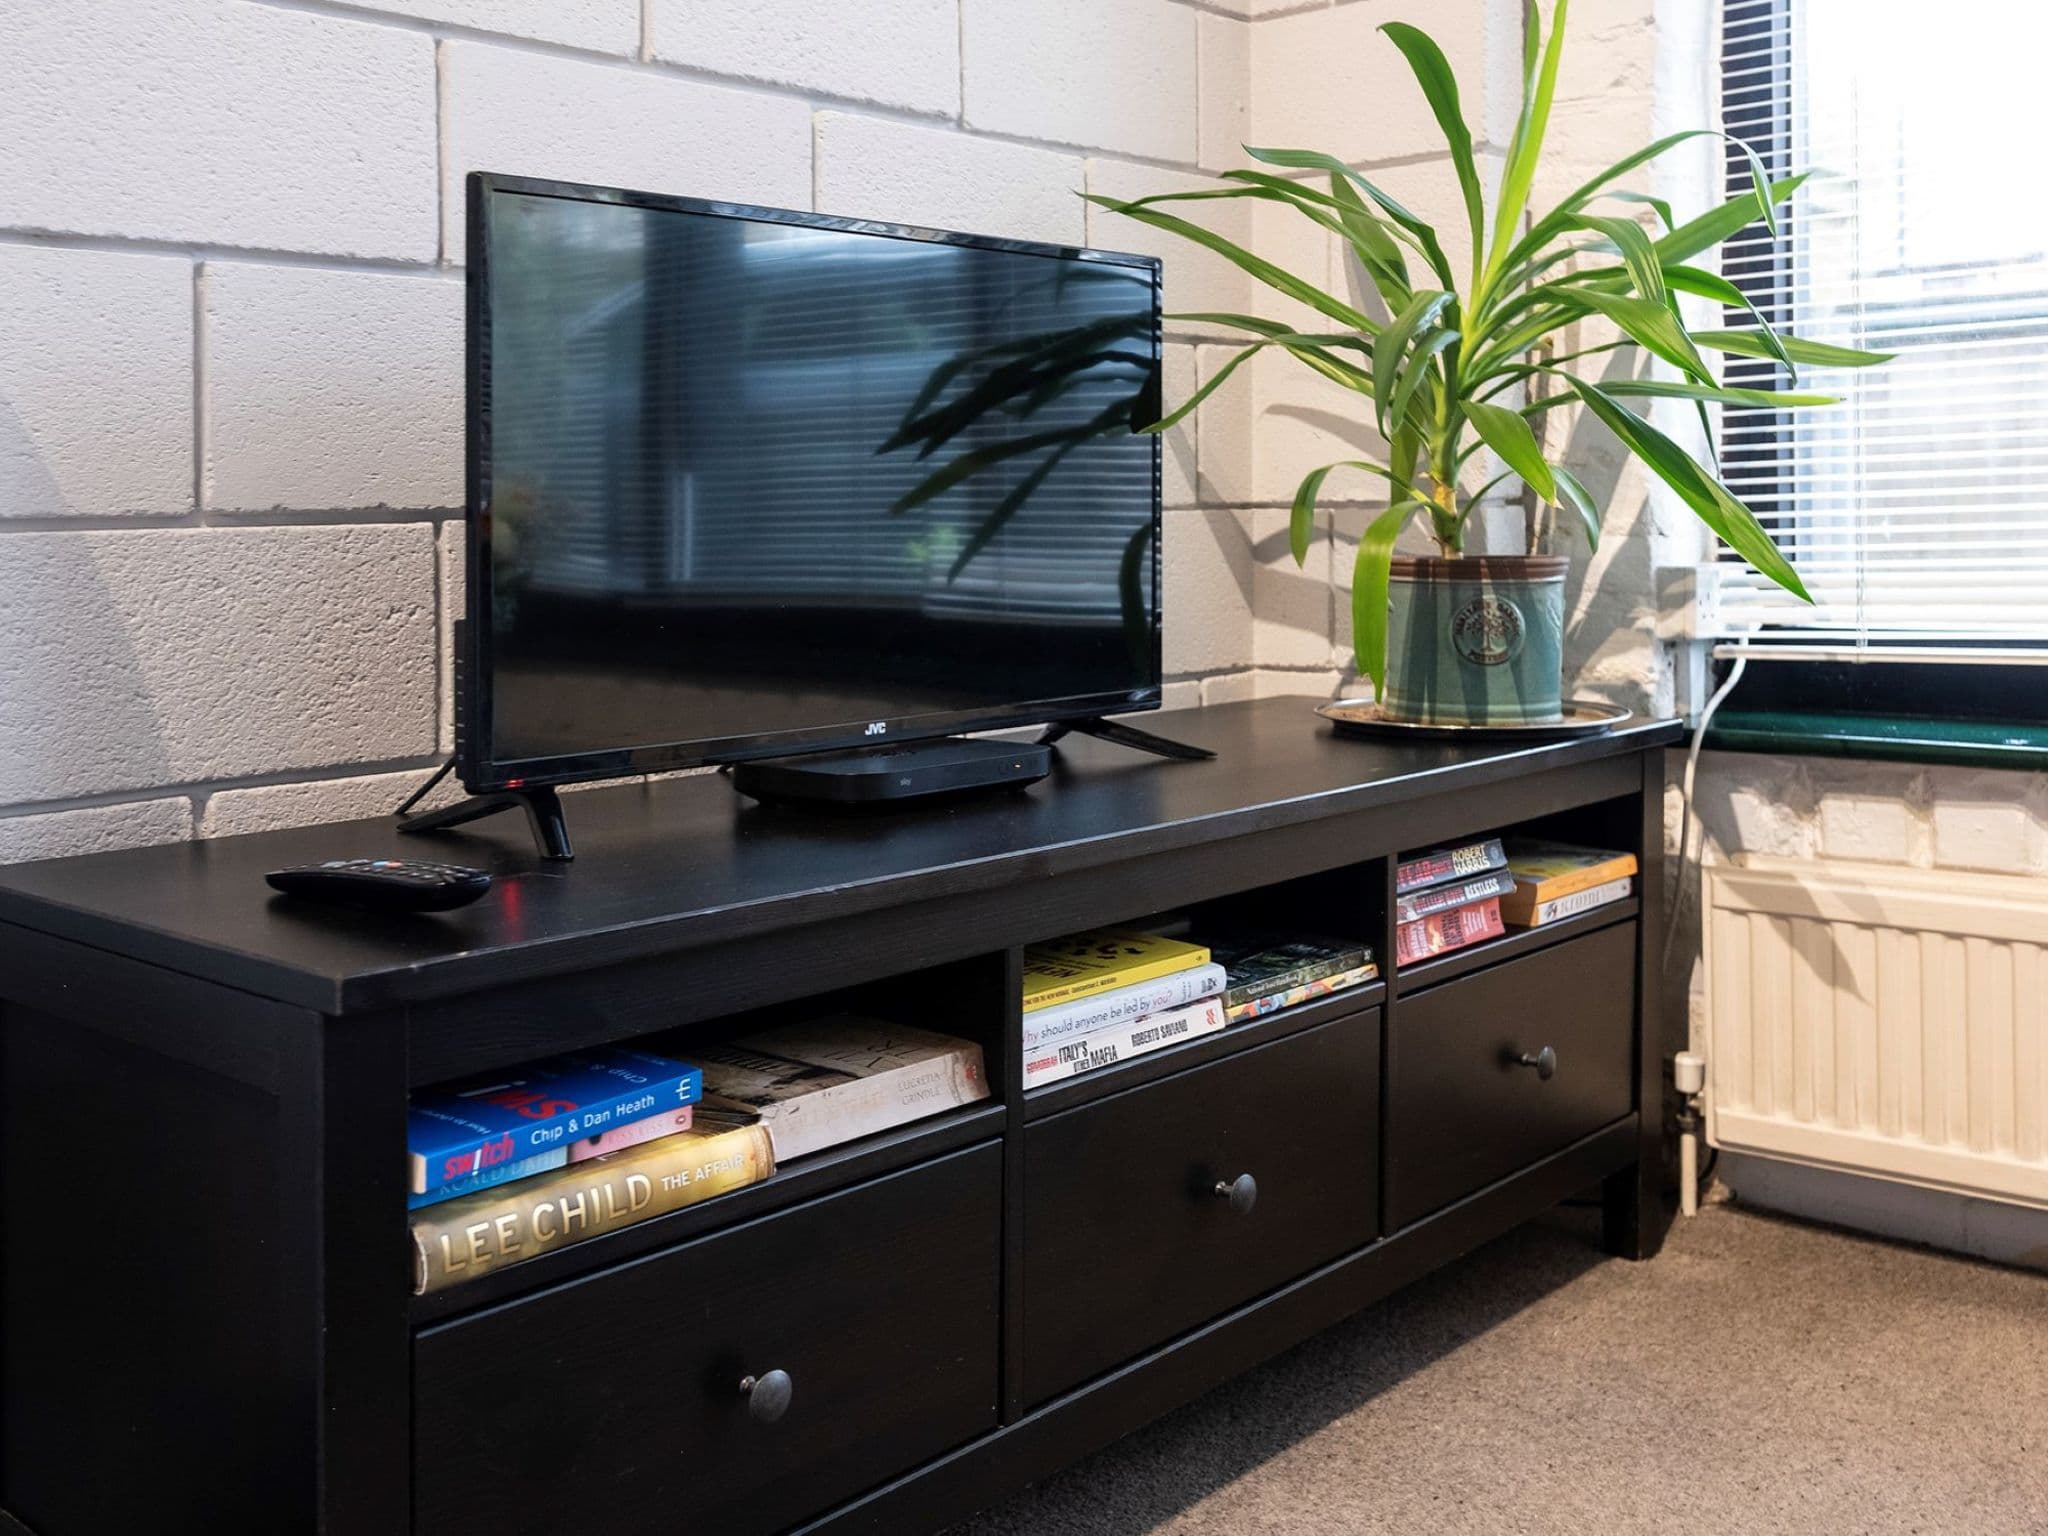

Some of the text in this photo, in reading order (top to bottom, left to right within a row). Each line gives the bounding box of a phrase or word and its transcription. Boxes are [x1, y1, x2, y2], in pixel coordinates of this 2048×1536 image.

[864, 722, 887, 736] JVC
[1452, 844, 1486, 862] ROBERT
[1454, 856, 1491, 876] HARRIS
[1464, 878, 1500, 899] RESTLESS
[1041, 1018, 1072, 1038] should
[1075, 1012, 1108, 1028] anyone
[1111, 1006, 1122, 1018] be
[1124, 999, 1137, 1013] led
[1140, 998, 1150, 1011] by
[1153, 990, 1173, 1007] you?
[1131, 1028, 1160, 1047] ROBERTO
[1059, 1040, 1089, 1065] ITALY'S
[1090, 1044, 1119, 1068] MAFIA
[531, 1094, 655, 1146] Chip & Dan Heath
[439, 1154, 745, 1273] LEE CHILD THE AFFAIR
